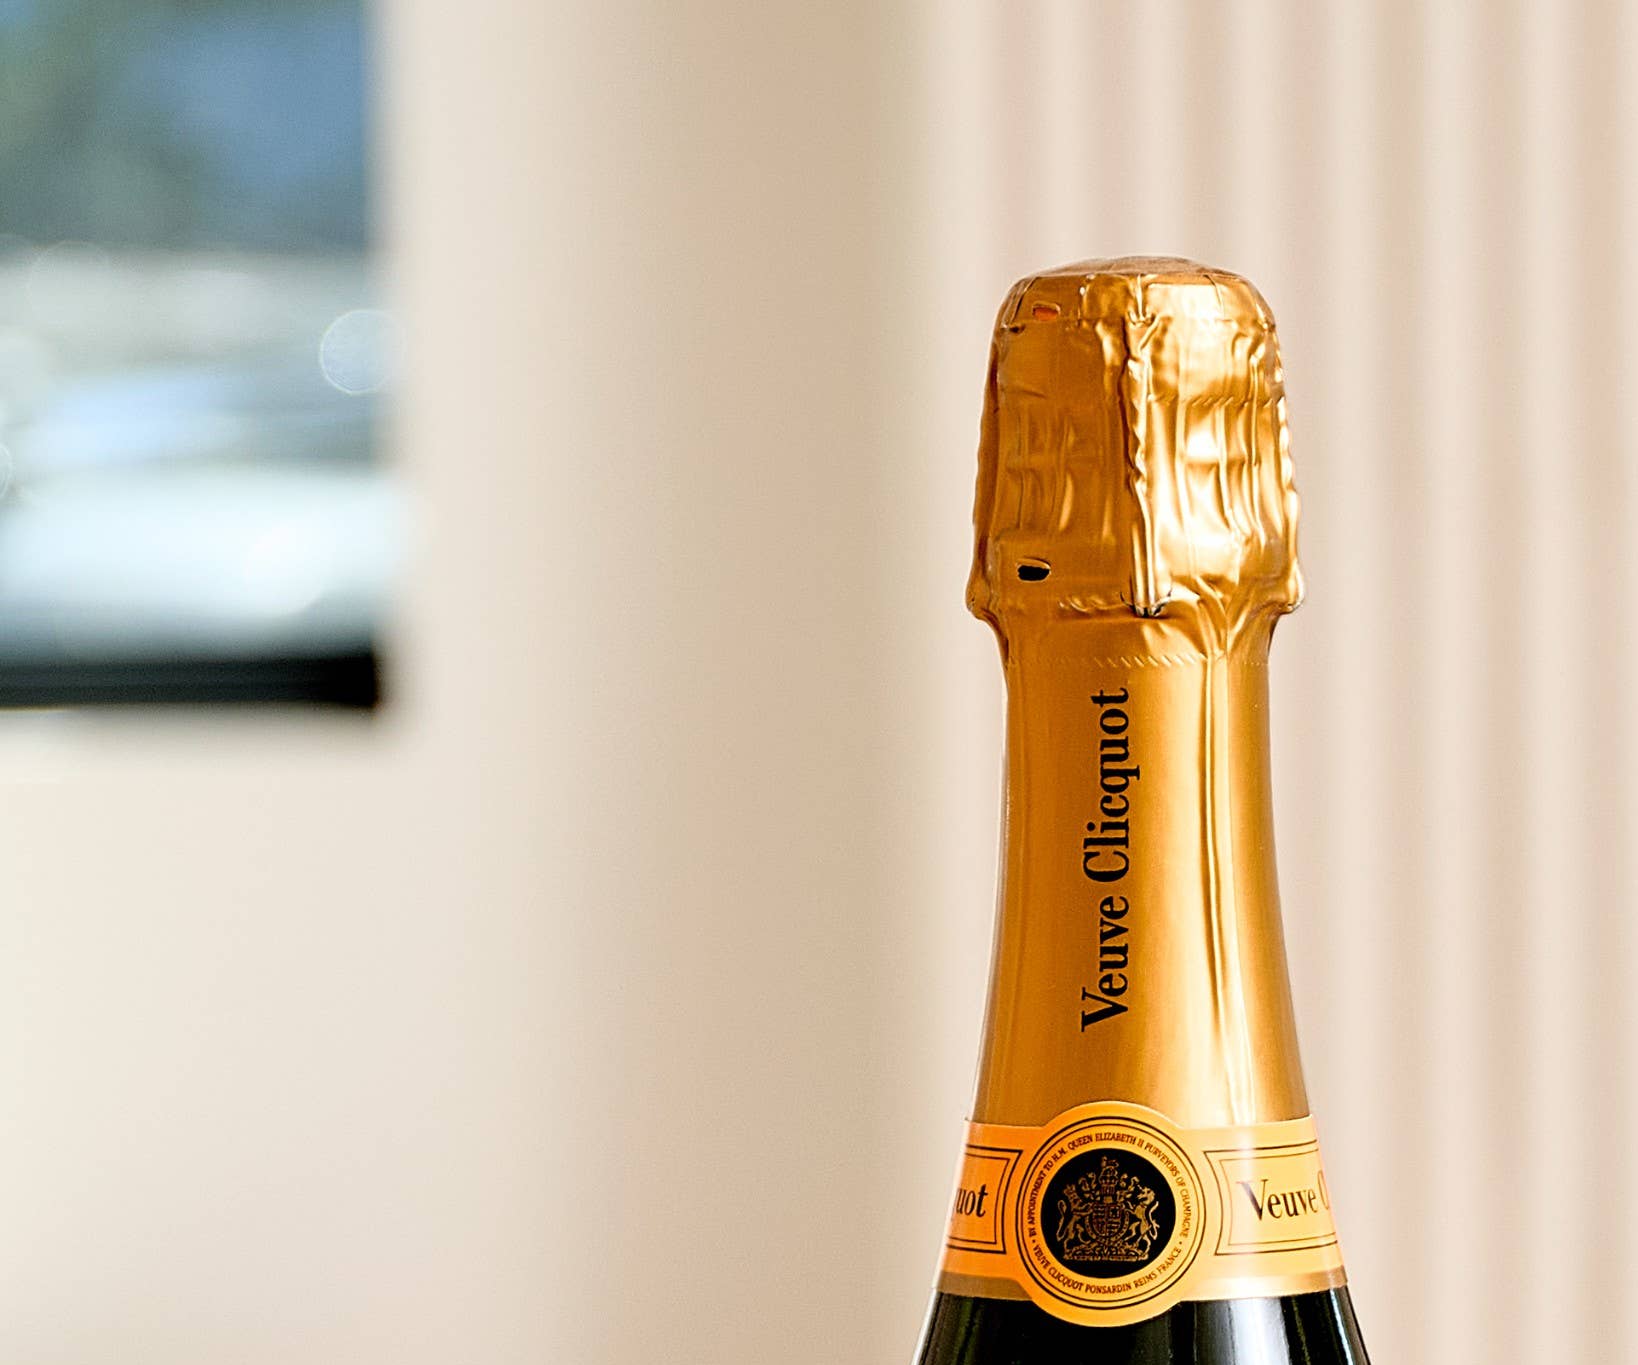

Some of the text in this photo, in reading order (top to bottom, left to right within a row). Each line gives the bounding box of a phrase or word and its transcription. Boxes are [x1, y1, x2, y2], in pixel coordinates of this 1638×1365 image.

[1080, 687, 1140, 1033] Veuve Clicquot
[1067, 1134, 1093, 1151] QUEEN
[1094, 1132, 1137, 1145] ELIZABETH
[1043, 1160, 1054, 1171] TO
[1144, 1142, 1180, 1177] PURVEYORS
[1026, 1169, 1047, 1225] APPOINTMENT
[1176, 1176, 1186, 1187] OF
[1236, 1179, 1318, 1221] Veuve
[1180, 1188, 1192, 1238] CHAMPAGNE
[1033, 1244, 1182, 1295] VEUVE CLICQUOT PONSARDIN REIMS FRANCE
